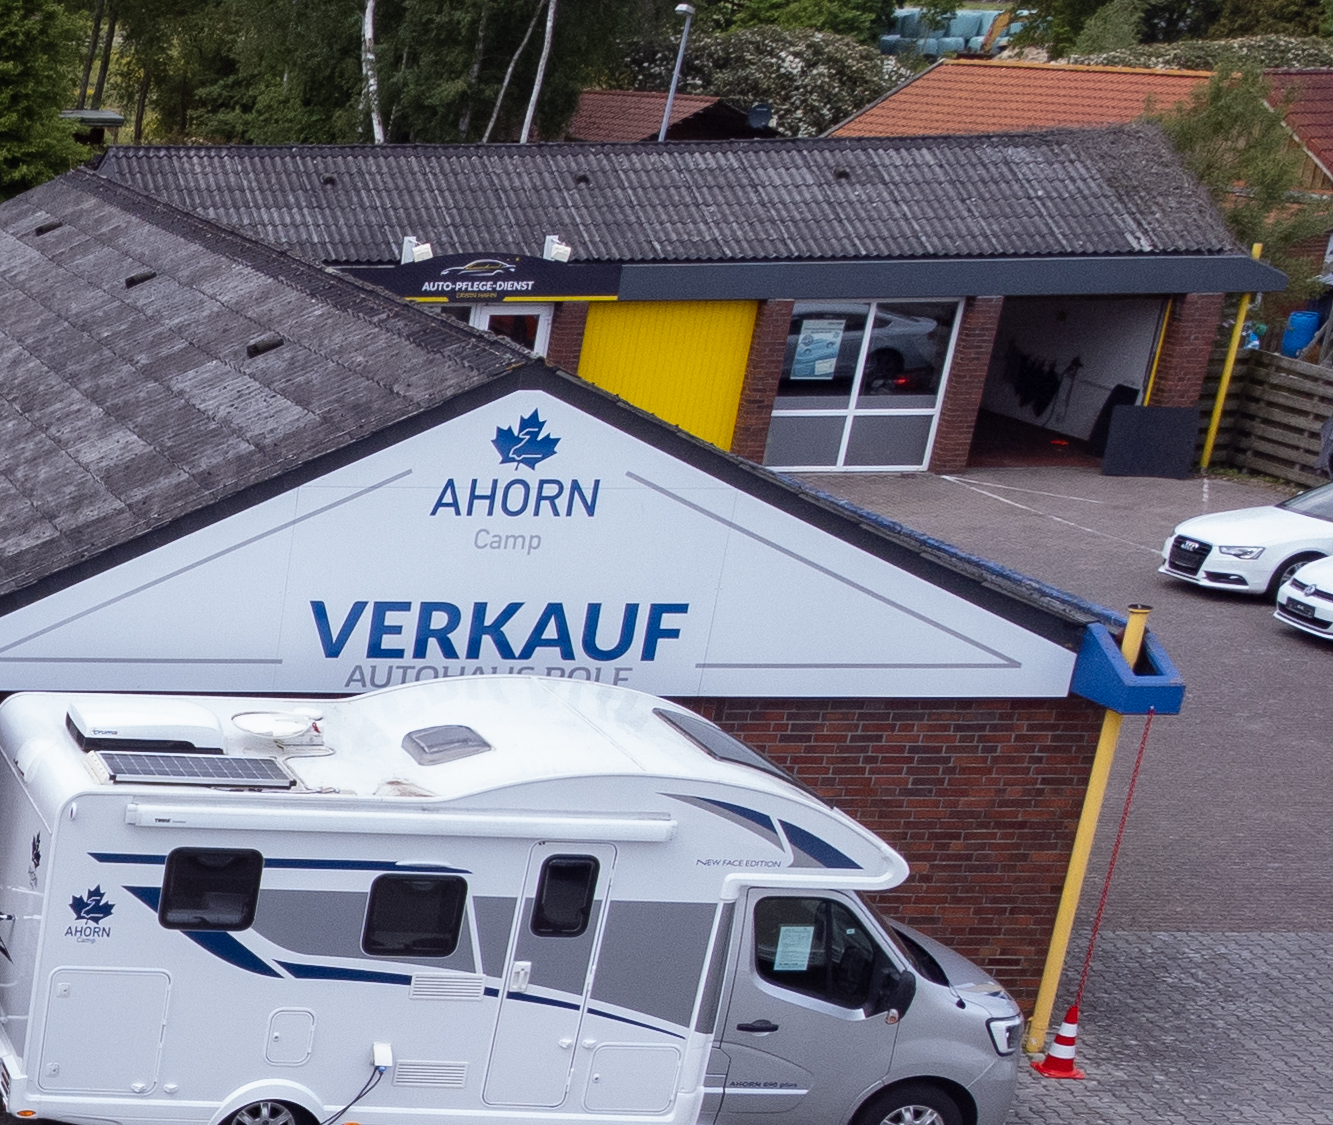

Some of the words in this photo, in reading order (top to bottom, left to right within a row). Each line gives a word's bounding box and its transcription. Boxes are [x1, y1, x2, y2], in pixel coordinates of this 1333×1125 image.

[422, 281, 535, 291] AUTO-PFLEGE-DIENST
[430, 478, 601, 518] AHORN
[473, 528, 542, 555] Camp
[309, 600, 690, 662] VERKAUF
[696, 859, 721, 867] NEW
[745, 860, 782, 868] EDITION
[64, 926, 111, 938] AHORN
